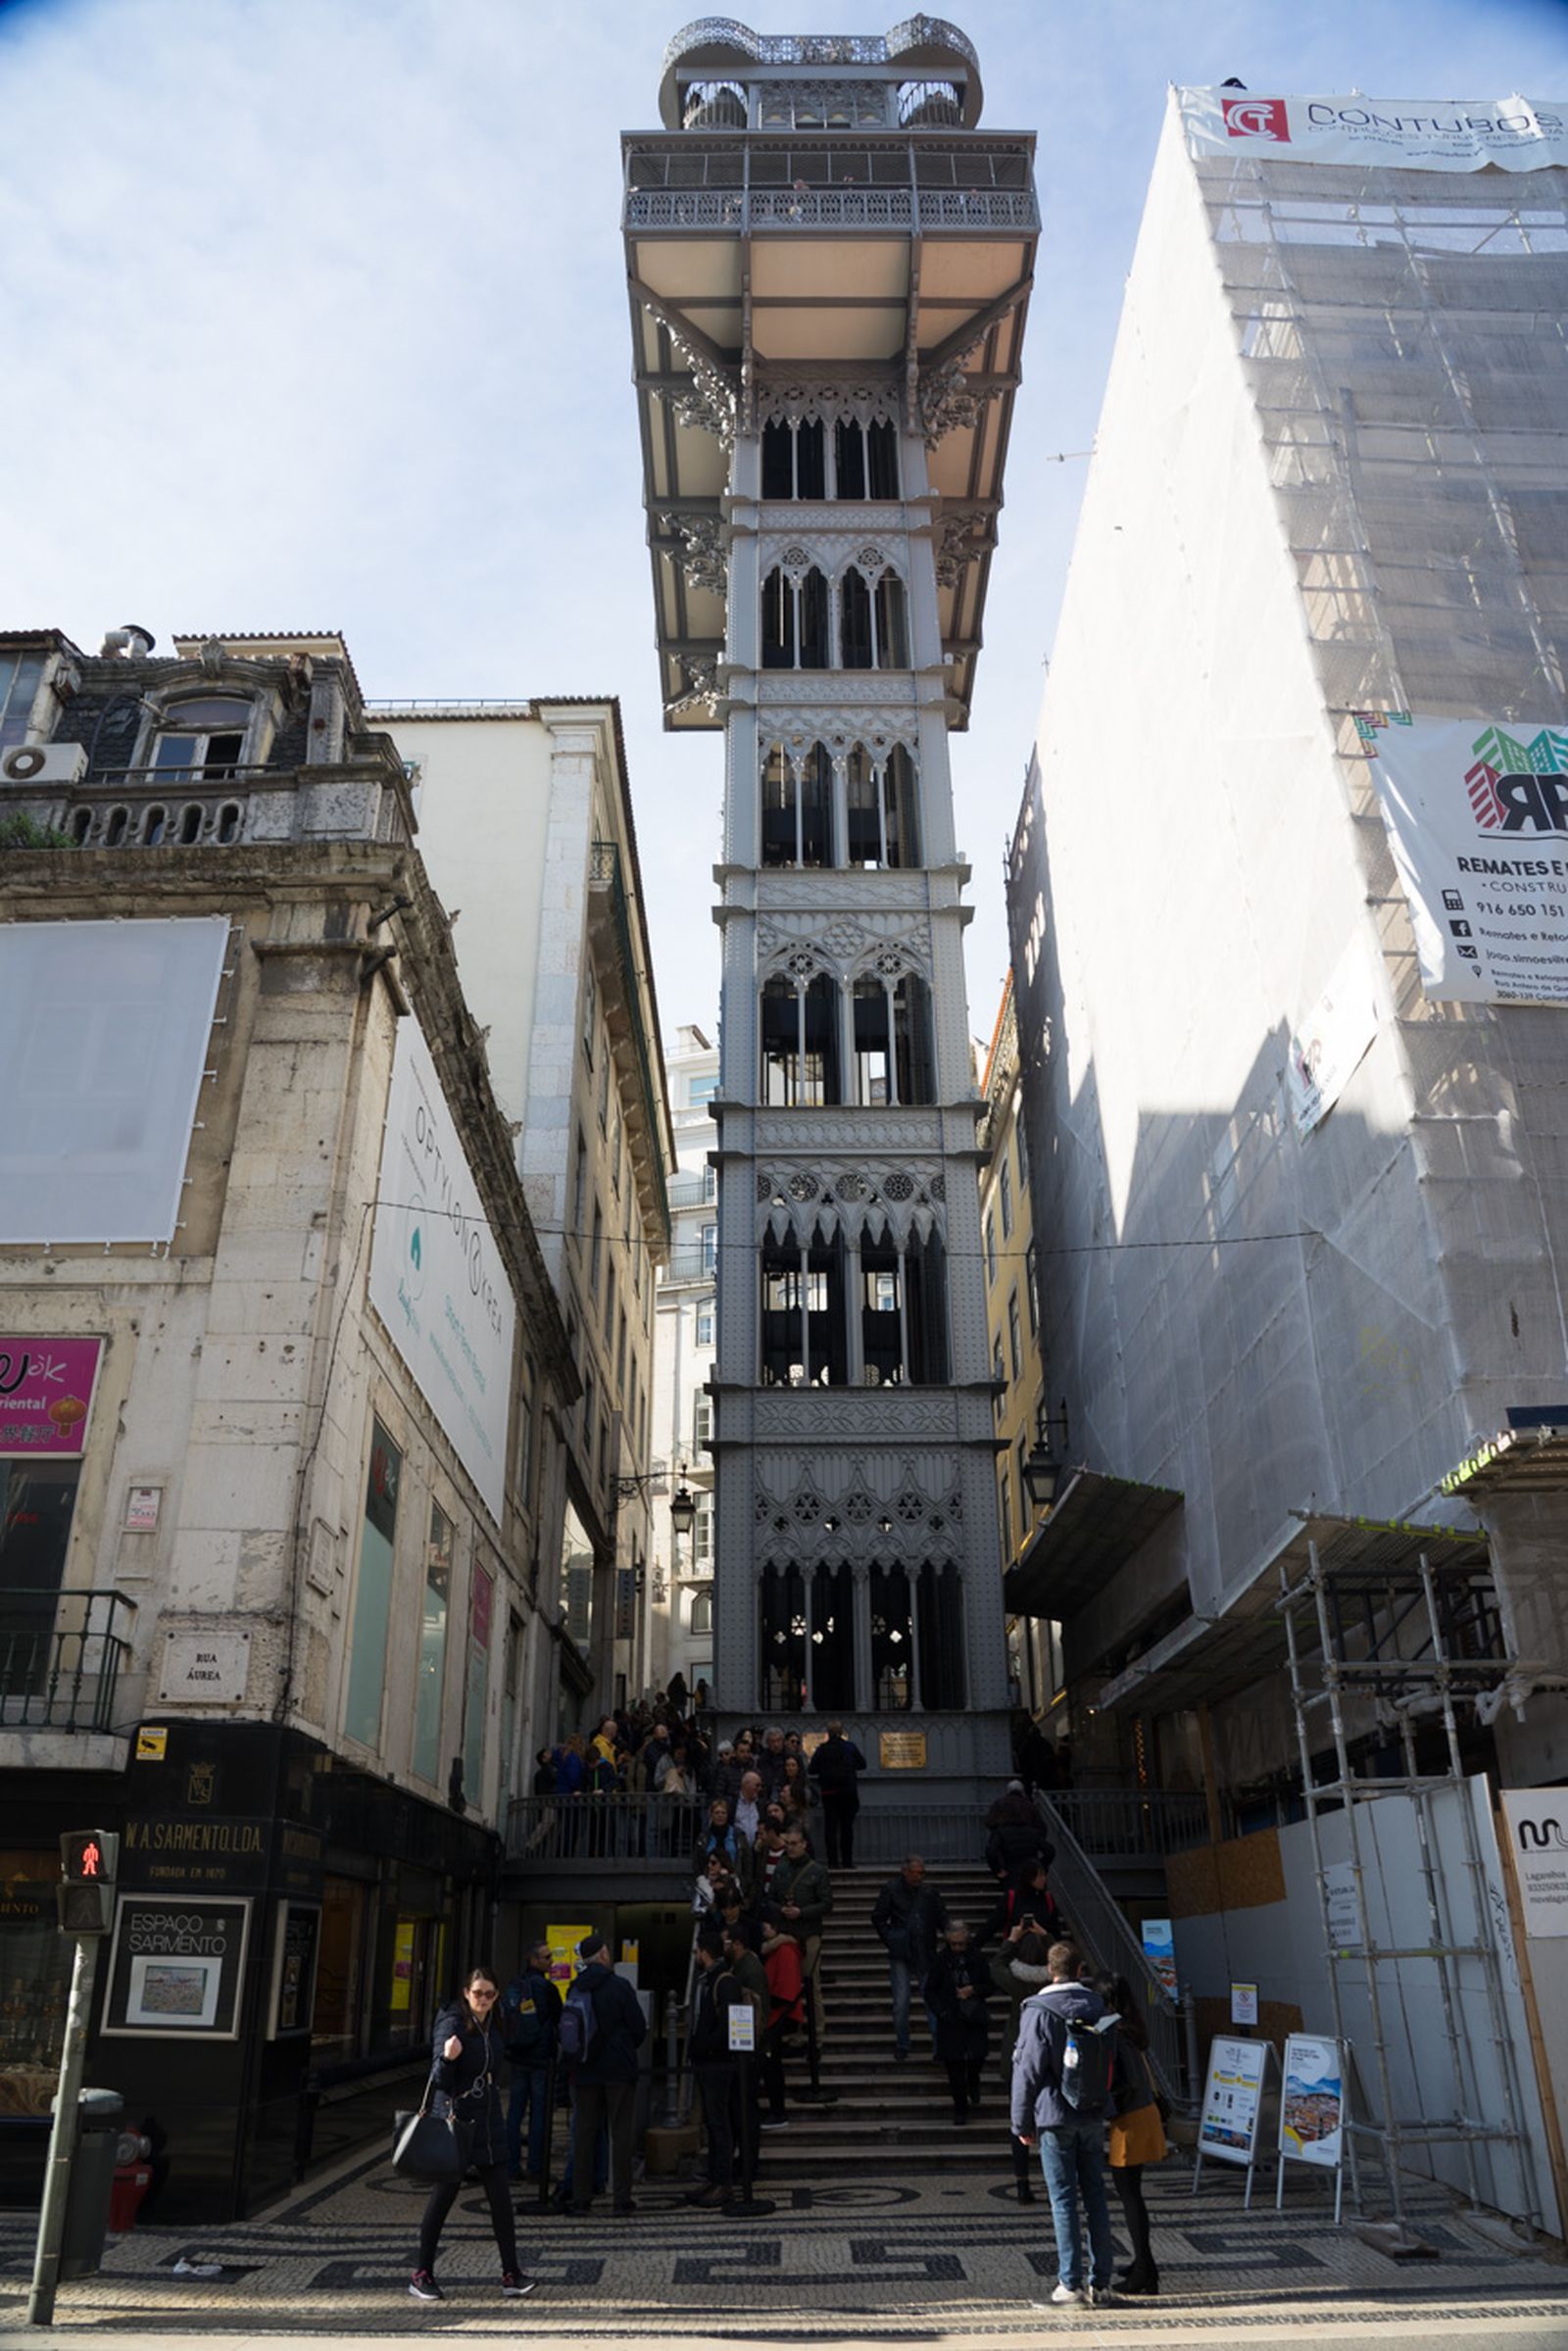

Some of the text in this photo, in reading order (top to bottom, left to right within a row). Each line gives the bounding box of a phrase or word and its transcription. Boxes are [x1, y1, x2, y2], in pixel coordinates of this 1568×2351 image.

[1306, 103, 1564, 133] CONTUBOS
[1456, 856, 1549, 876] REMATES
[1476, 901, 1566, 918] 916 650 151
[196, 1653, 219, 1664] RUA
[186, 1667, 221, 1682] ÁUREA
[130, 1913, 204, 1935] ESPAÇO
[127, 1933, 227, 1955] SARMENTO
